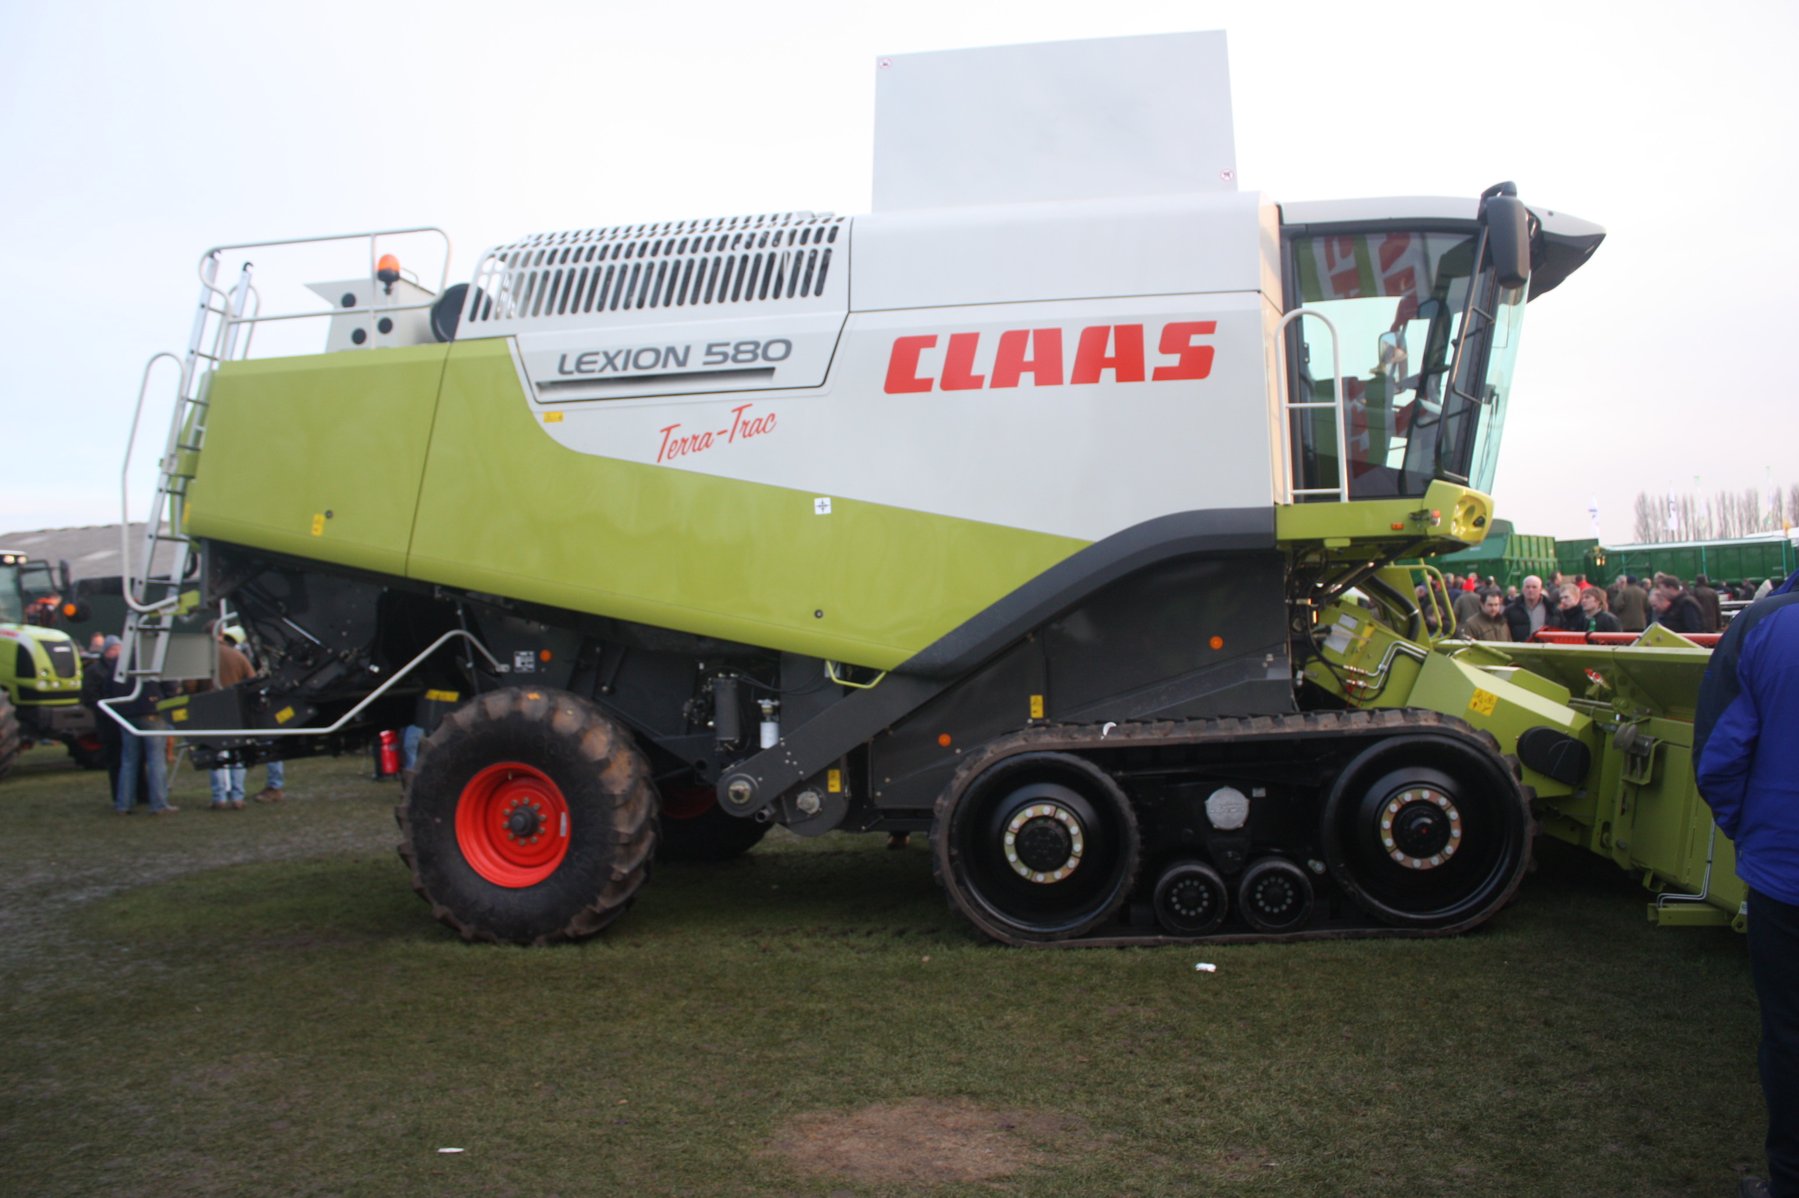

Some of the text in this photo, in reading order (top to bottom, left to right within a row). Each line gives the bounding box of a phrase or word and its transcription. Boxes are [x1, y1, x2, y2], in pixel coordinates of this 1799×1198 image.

[557, 338, 793, 376] LEXION 580
[884, 320, 1217, 395] CLAAS
[656, 403, 777, 463] Terra-Trac
